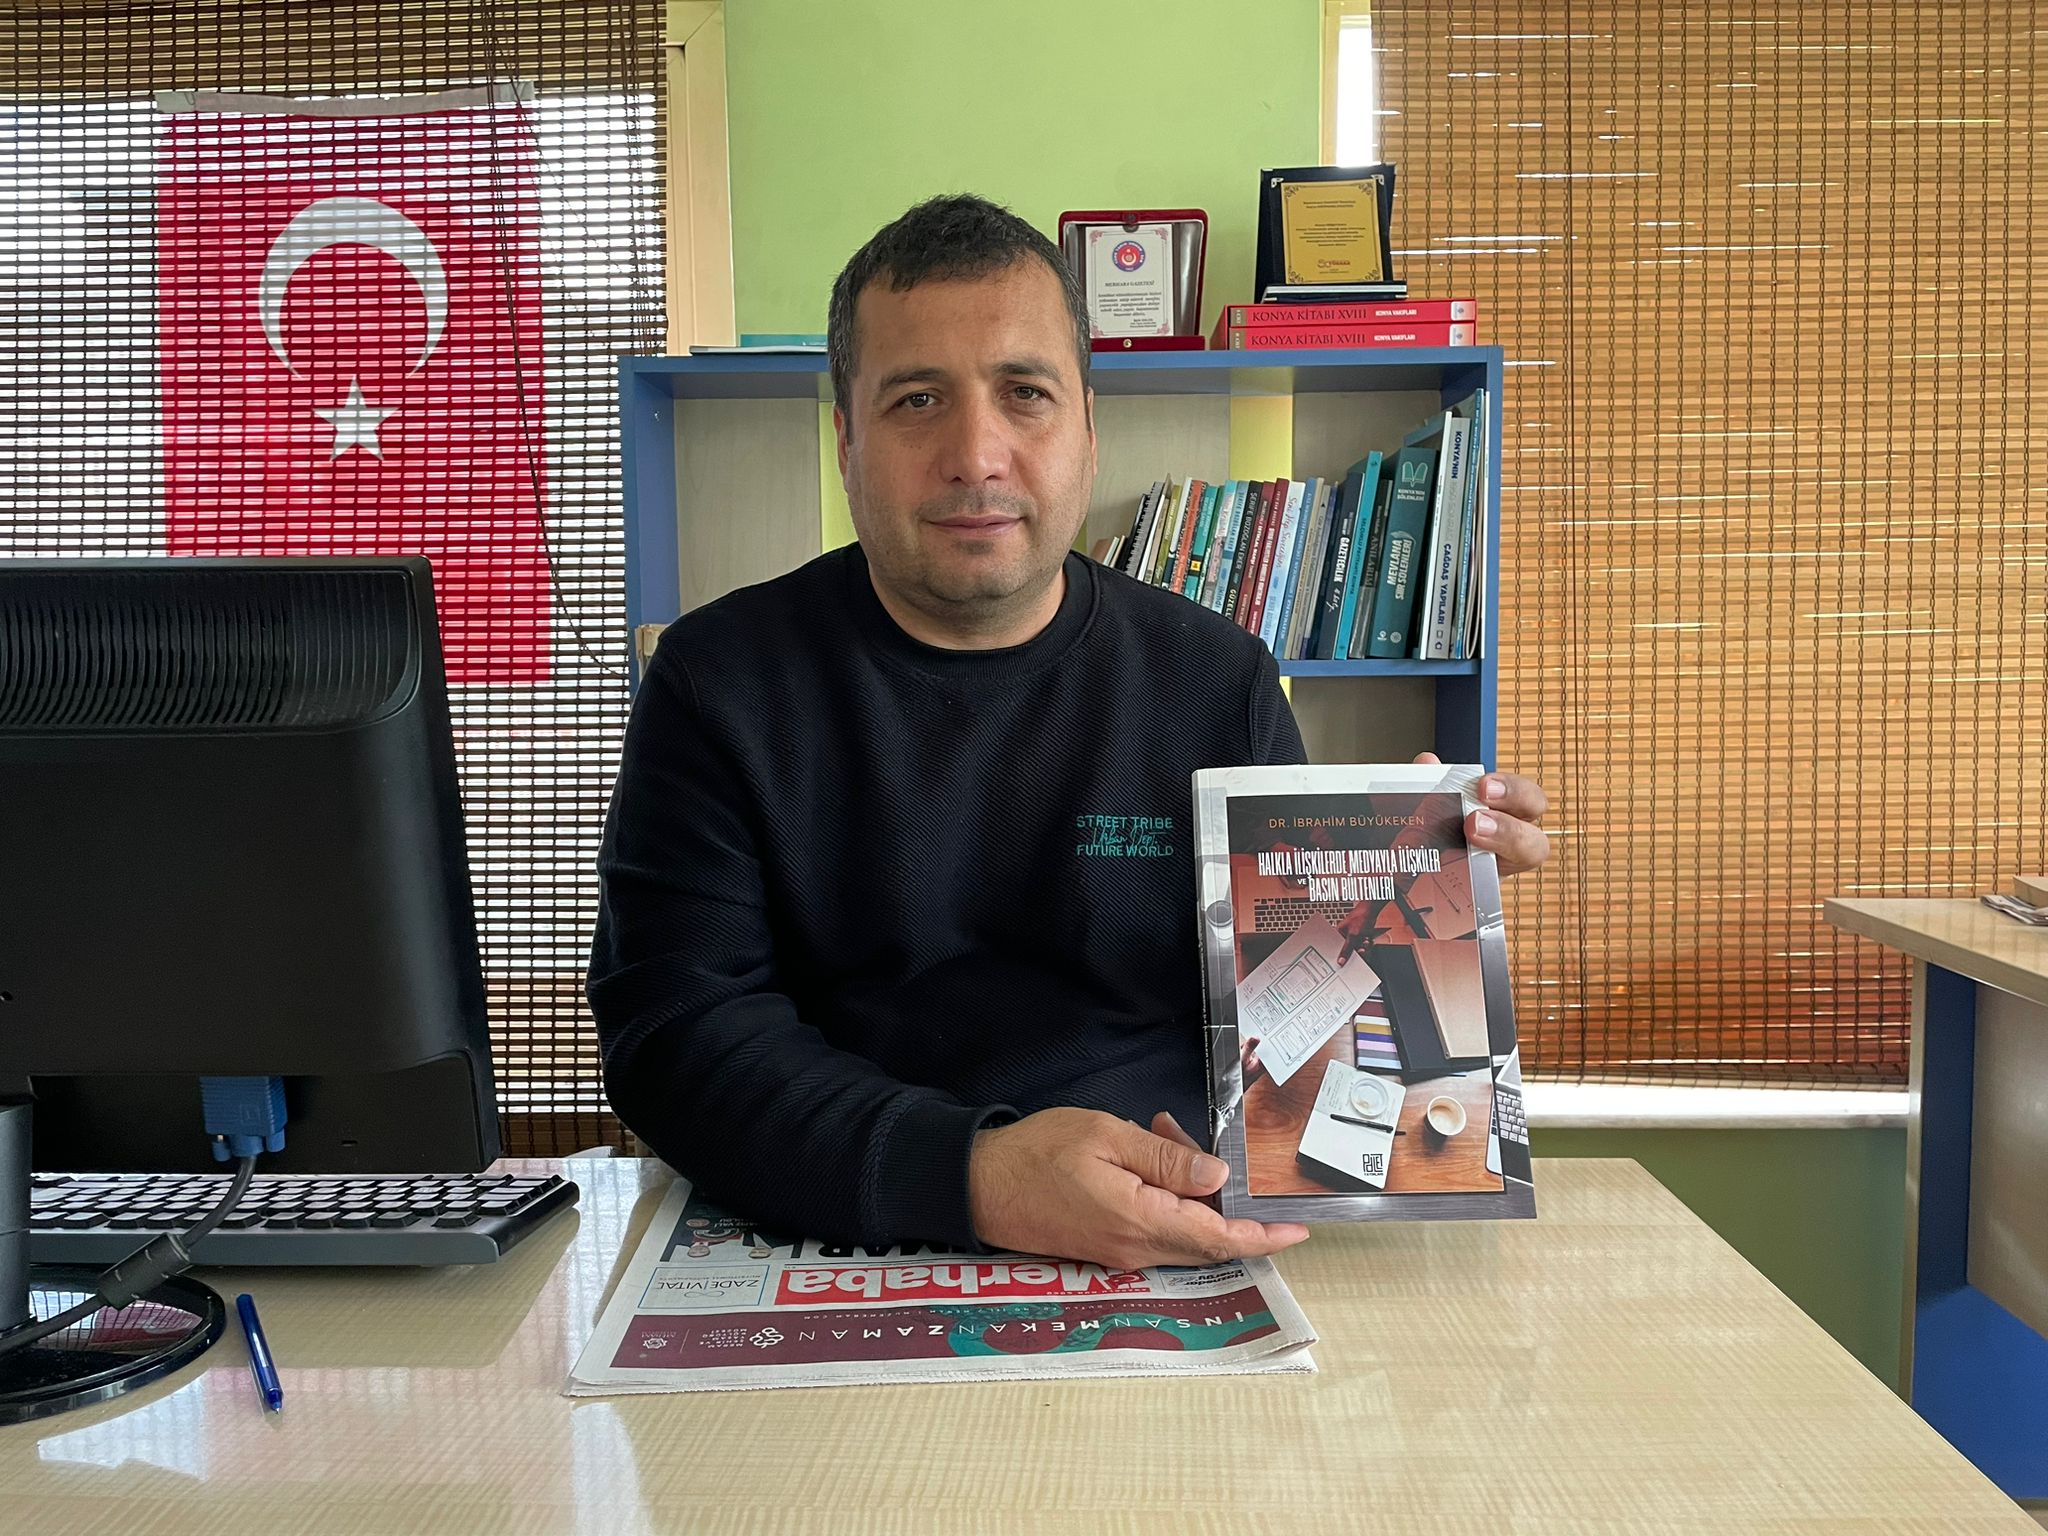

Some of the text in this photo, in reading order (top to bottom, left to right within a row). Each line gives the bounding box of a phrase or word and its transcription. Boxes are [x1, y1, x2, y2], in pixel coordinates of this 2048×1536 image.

[1253, 312, 1294, 321] KONYA
[1298, 308, 1334, 320] KİTABI
[1338, 308, 1366, 319] XVIII
[1251, 336, 1293, 345] KONYA
[1296, 332, 1333, 345] KİTABI
[1337, 334, 1365, 344] XVIII
[1452, 431, 1462, 479] KONYA'NIN
[1334, 537, 1351, 582] GAZETECİLİK
[1386, 539, 1402, 585] MEVLANA
[1440, 543, 1451, 580] ÇAĞDAŞ
[1224, 588, 1238, 619] GÜZELL
[1438, 583, 1448, 625] YAPILARI
[1076, 815, 1173, 829] STREET TRIBE
[1269, 814, 1424, 829] DR. İBRAHİM BÜYÜKEKEN
[1076, 844, 1174, 857] FUTURE WORLD
[1258, 845, 1442, 878] HALKLA İLİŞKİLERDE MEDYAYLA İLİŞKİLER
[1308, 877, 1339, 902] BASIN
[1342, 872, 1396, 901] BÜLTENLERİ
[711, 1279, 759, 1289] ZADE
[788, 1263, 1150, 1298] Merhaba
